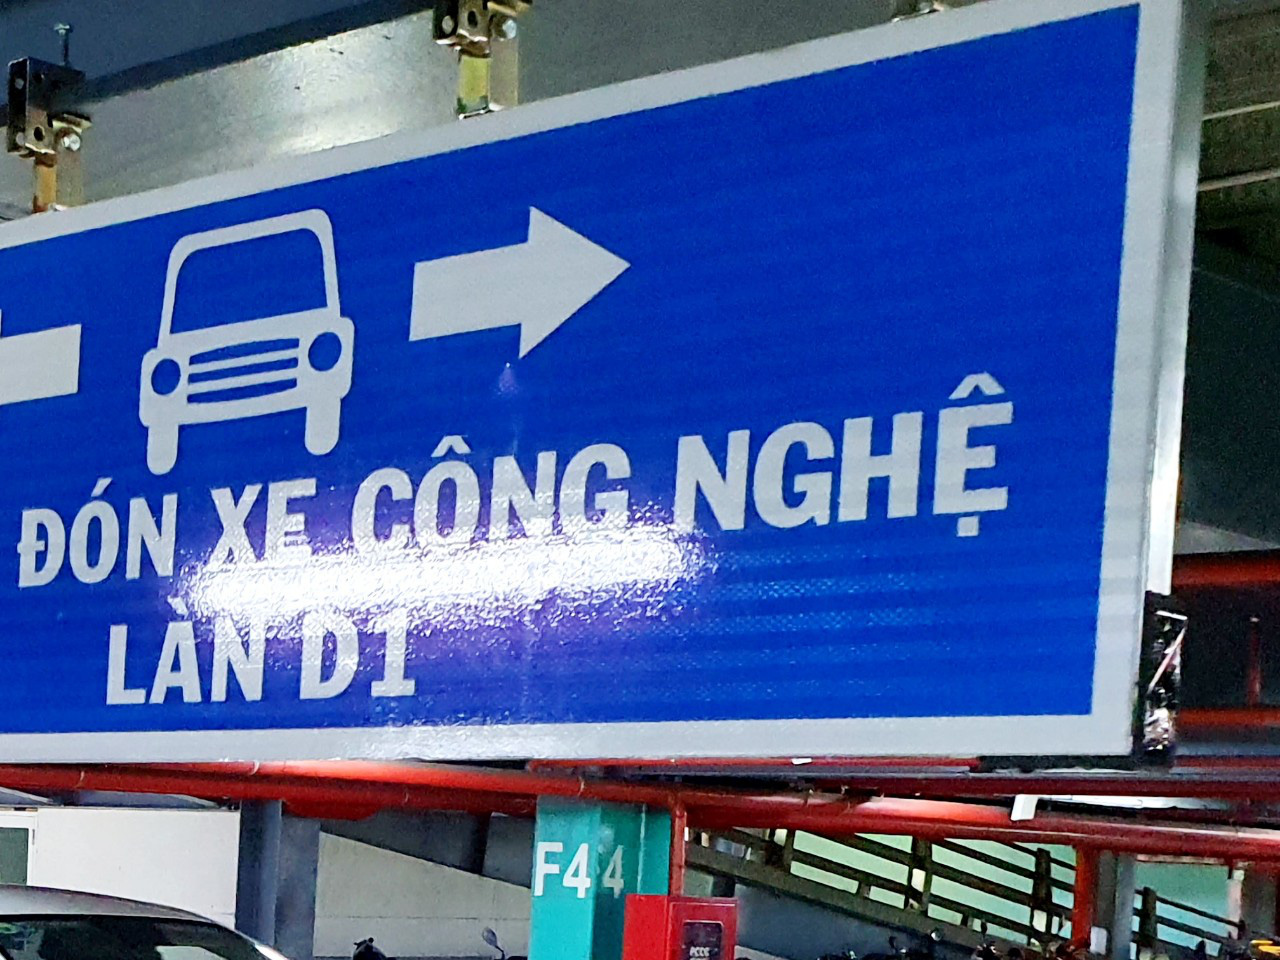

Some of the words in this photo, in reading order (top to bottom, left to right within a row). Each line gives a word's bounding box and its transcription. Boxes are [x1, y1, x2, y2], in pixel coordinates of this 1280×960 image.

[17, 477, 179, 588] ĐÓN
[209, 476, 318, 567] XE
[350, 434, 632, 556] CÔNG
[674, 371, 1015, 537] NGHỆ
[106, 594, 267, 706] LÀN
[299, 608, 417, 700] D1
[533, 841, 591, 898] F4
